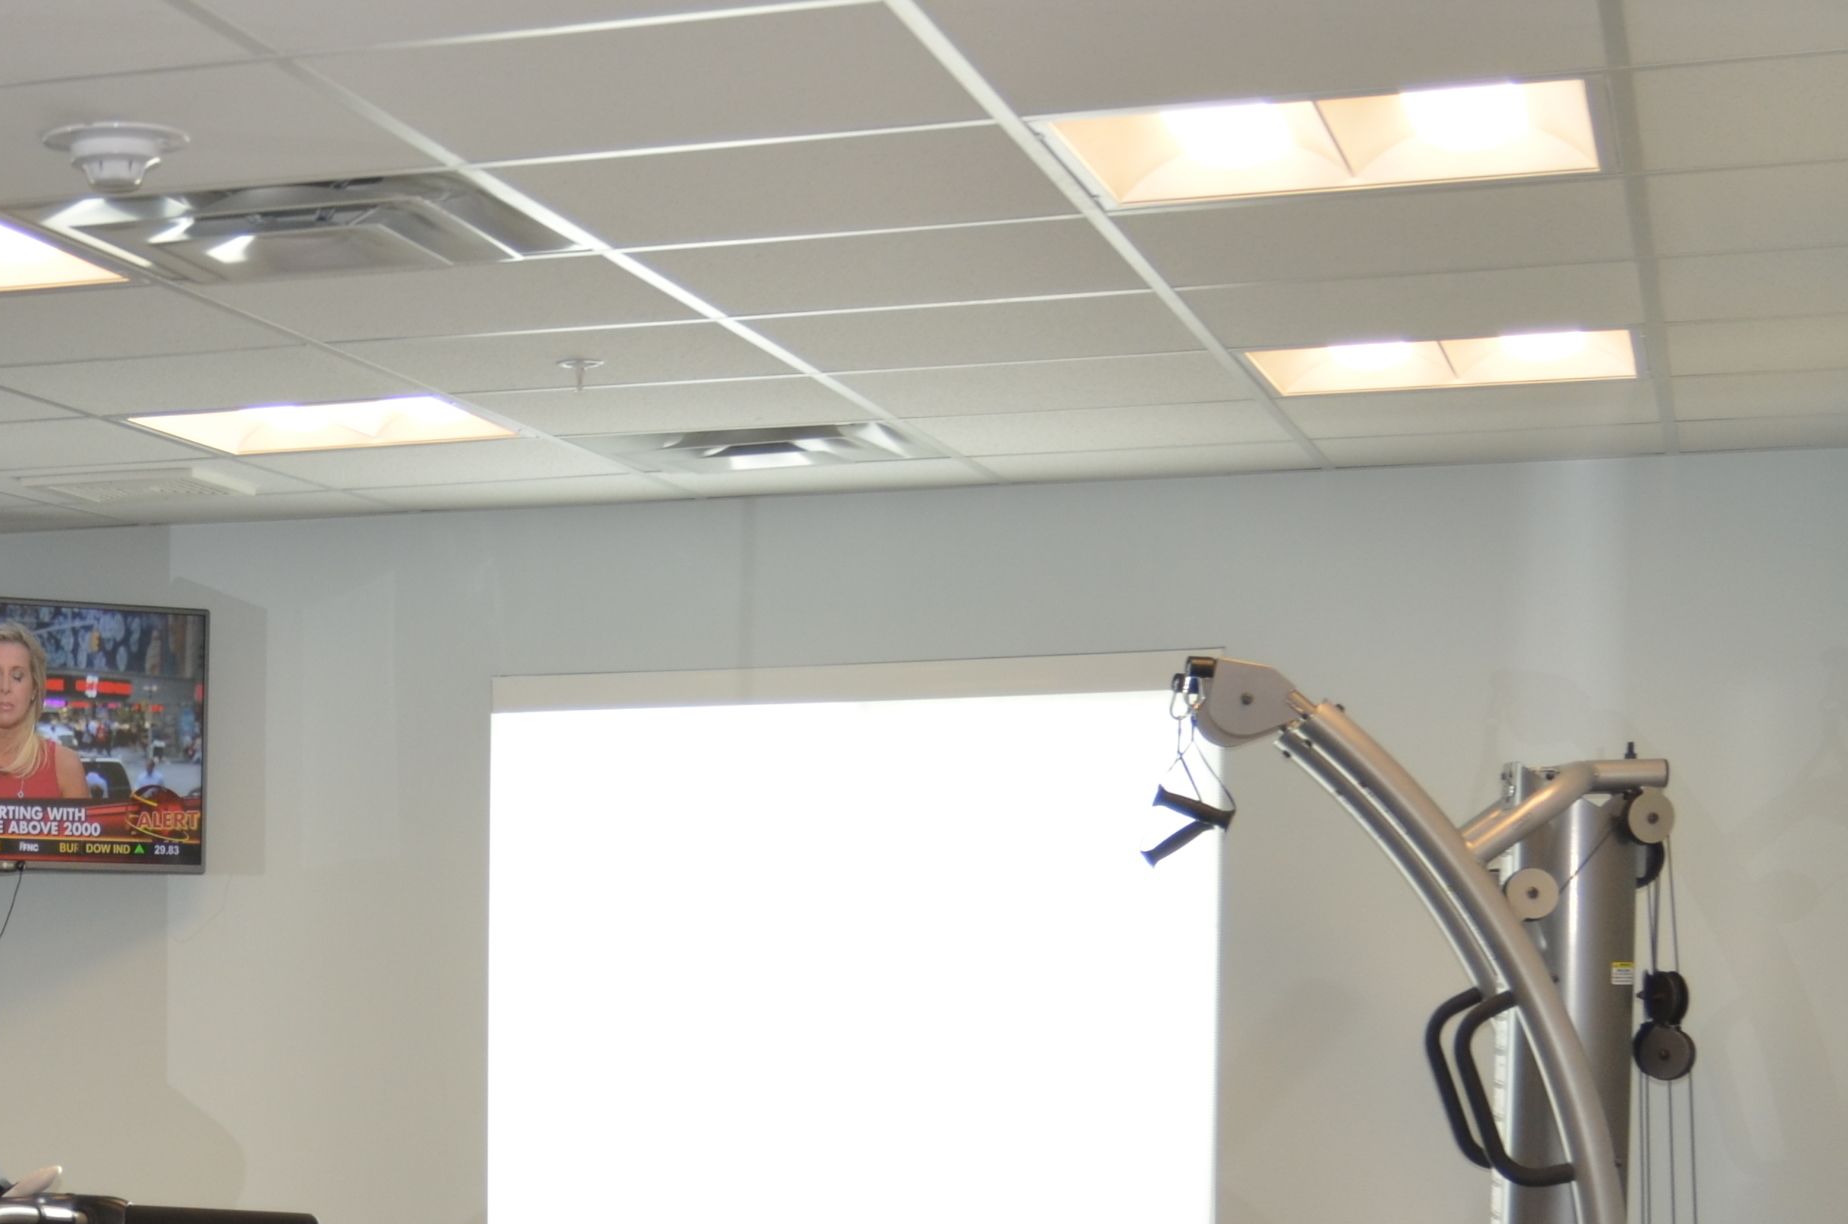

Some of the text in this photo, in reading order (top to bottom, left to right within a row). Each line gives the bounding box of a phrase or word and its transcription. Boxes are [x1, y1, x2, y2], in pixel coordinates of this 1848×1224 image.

[47, 806, 86, 822] WITH
[136, 810, 200, 831] ALERT
[8, 820, 59, 836] ABOVE
[63, 822, 101, 837] 2000
[85, 843, 180, 856] DOW IND 29.83
